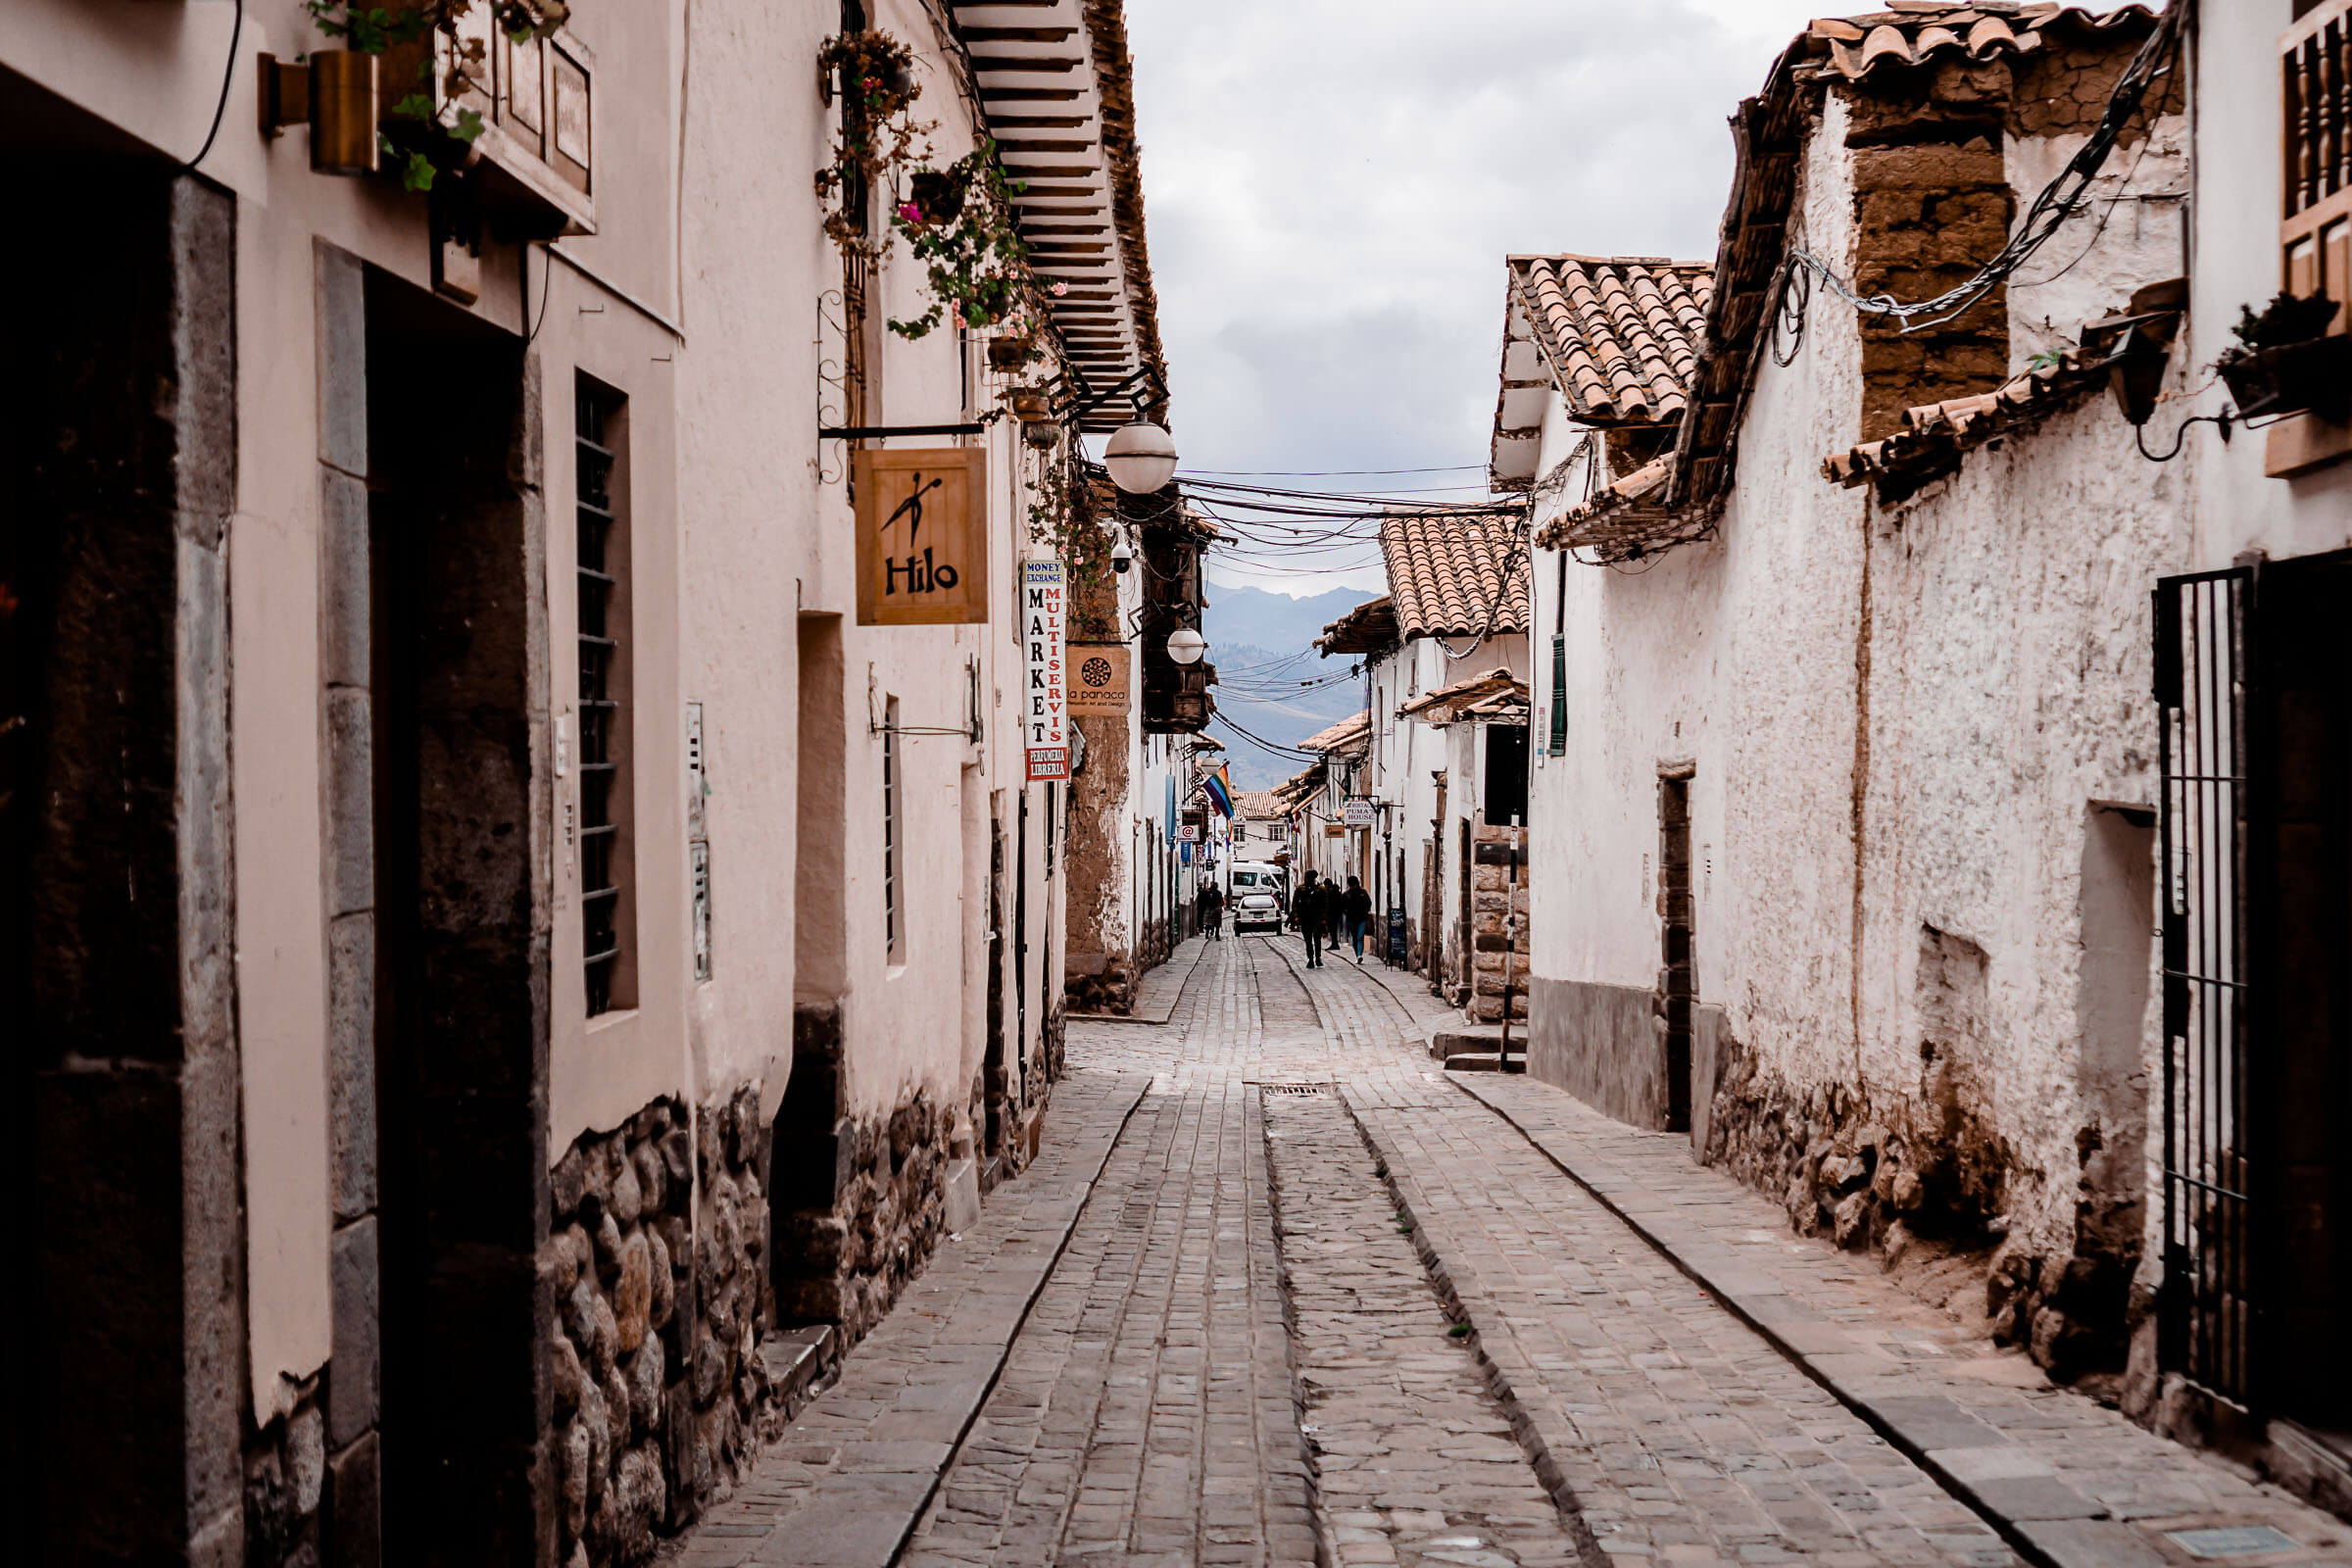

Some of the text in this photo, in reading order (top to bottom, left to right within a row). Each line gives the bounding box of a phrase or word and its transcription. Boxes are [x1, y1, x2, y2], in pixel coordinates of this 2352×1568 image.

[886, 546, 958, 596] Hilo
[1027, 563, 1061, 572] MONEY
[1026, 573, 1061, 583] EXCHANGE
[1029, 588, 1046, 743] MARKET
[1045, 588, 1062, 742] MULTISERVIS
[1081, 690, 1125, 701] panaca
[1030, 762, 1065, 777] LIBRERIA
